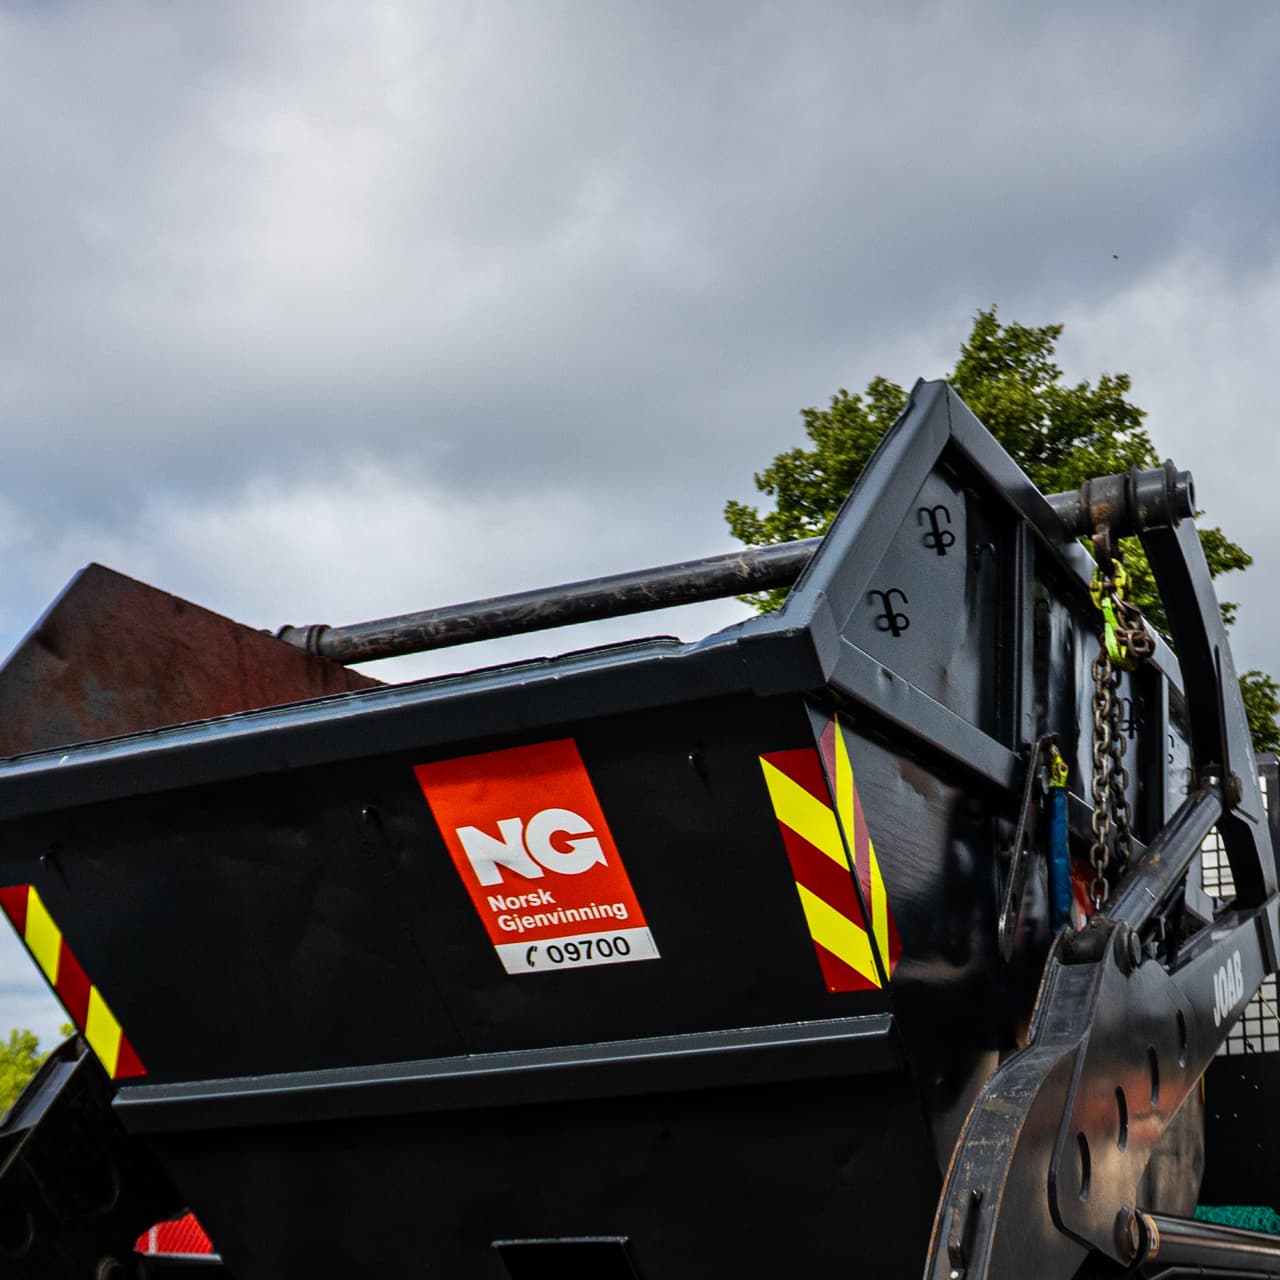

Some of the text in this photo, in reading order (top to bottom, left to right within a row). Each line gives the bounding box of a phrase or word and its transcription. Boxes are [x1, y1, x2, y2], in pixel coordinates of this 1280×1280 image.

[455, 808, 608, 886] NG
[487, 888, 556, 912] Norsk
[497, 902, 629, 933] Gjenvinning
[546, 936, 631, 964] 09700
[1213, 950, 1244, 1028] JOAB
